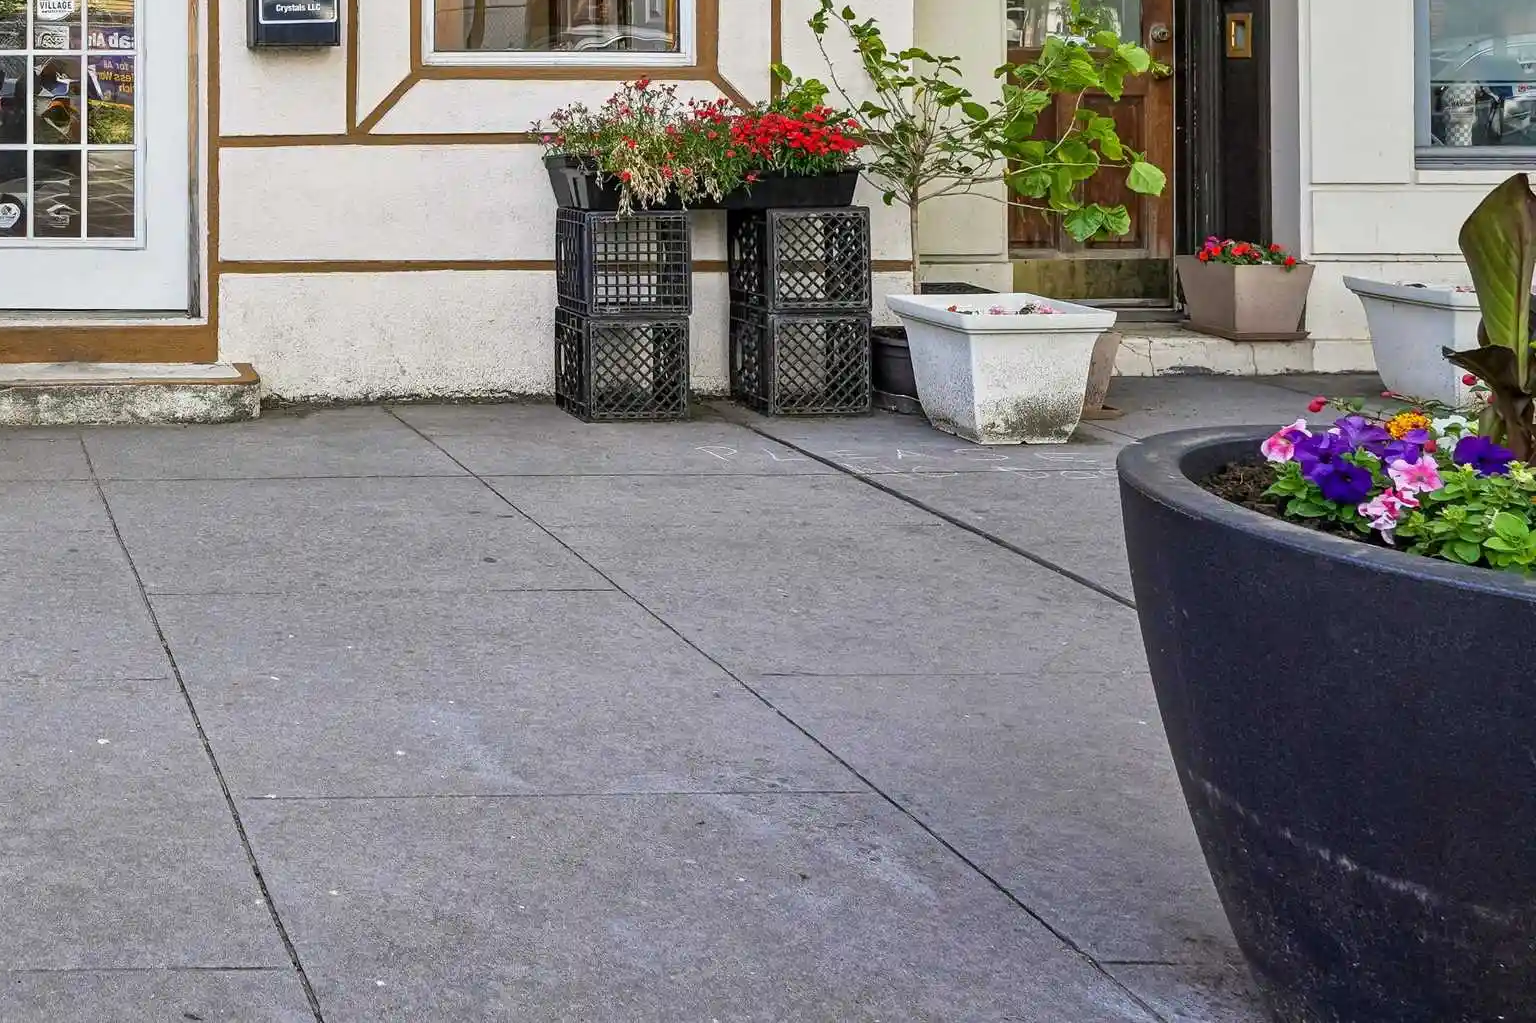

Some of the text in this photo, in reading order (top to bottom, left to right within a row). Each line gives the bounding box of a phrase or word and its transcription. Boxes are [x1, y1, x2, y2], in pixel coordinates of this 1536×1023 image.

[39, 1, 72, 10] VILLAGE
[275, 3, 321, 13] Crystals LLC
